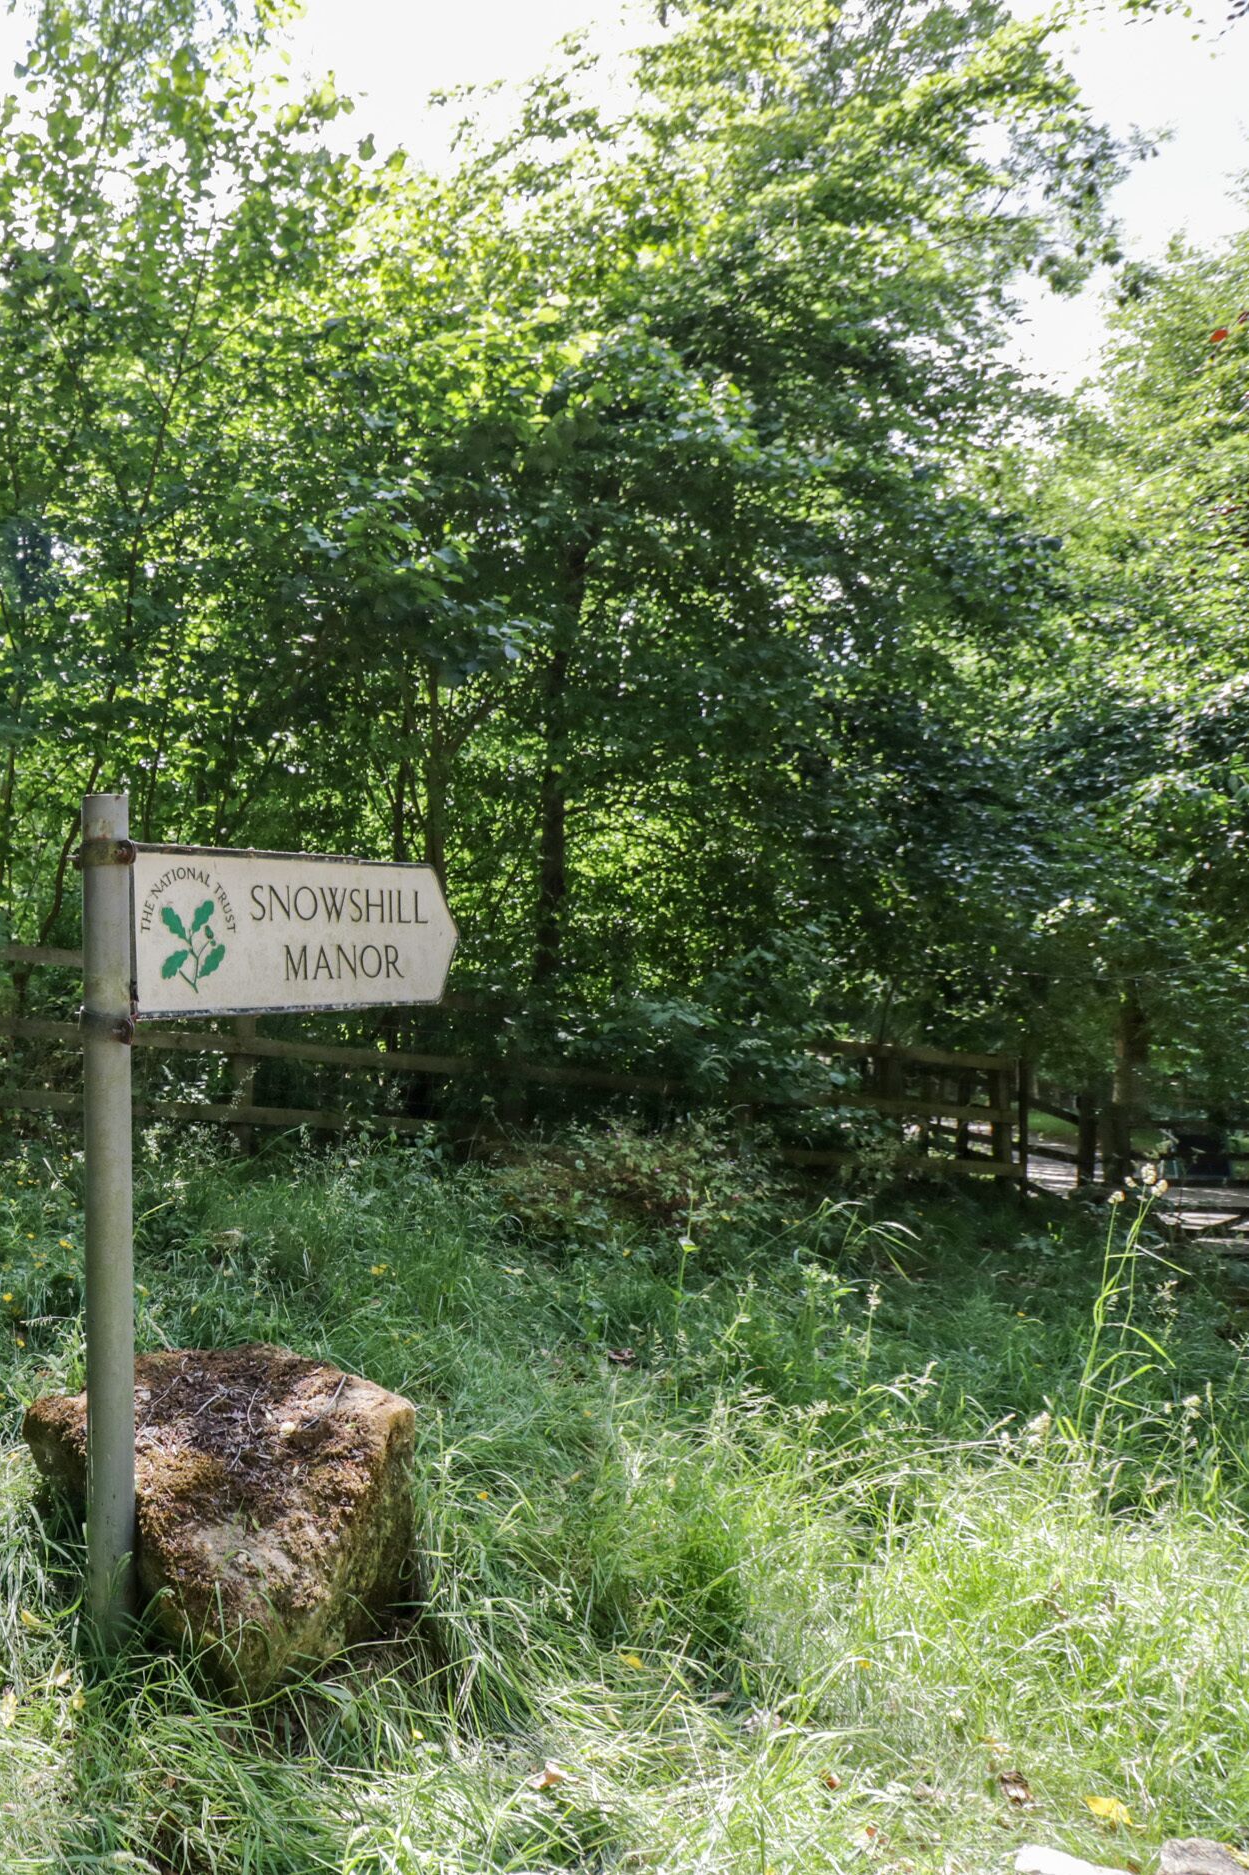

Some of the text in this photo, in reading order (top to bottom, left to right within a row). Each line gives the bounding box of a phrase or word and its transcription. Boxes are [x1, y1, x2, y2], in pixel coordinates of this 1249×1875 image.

[140, 866, 236, 934] THE NATIONAL TRUST
[250, 885, 429, 924] SNOWSHILL
[284, 945, 405, 981] MANOR
